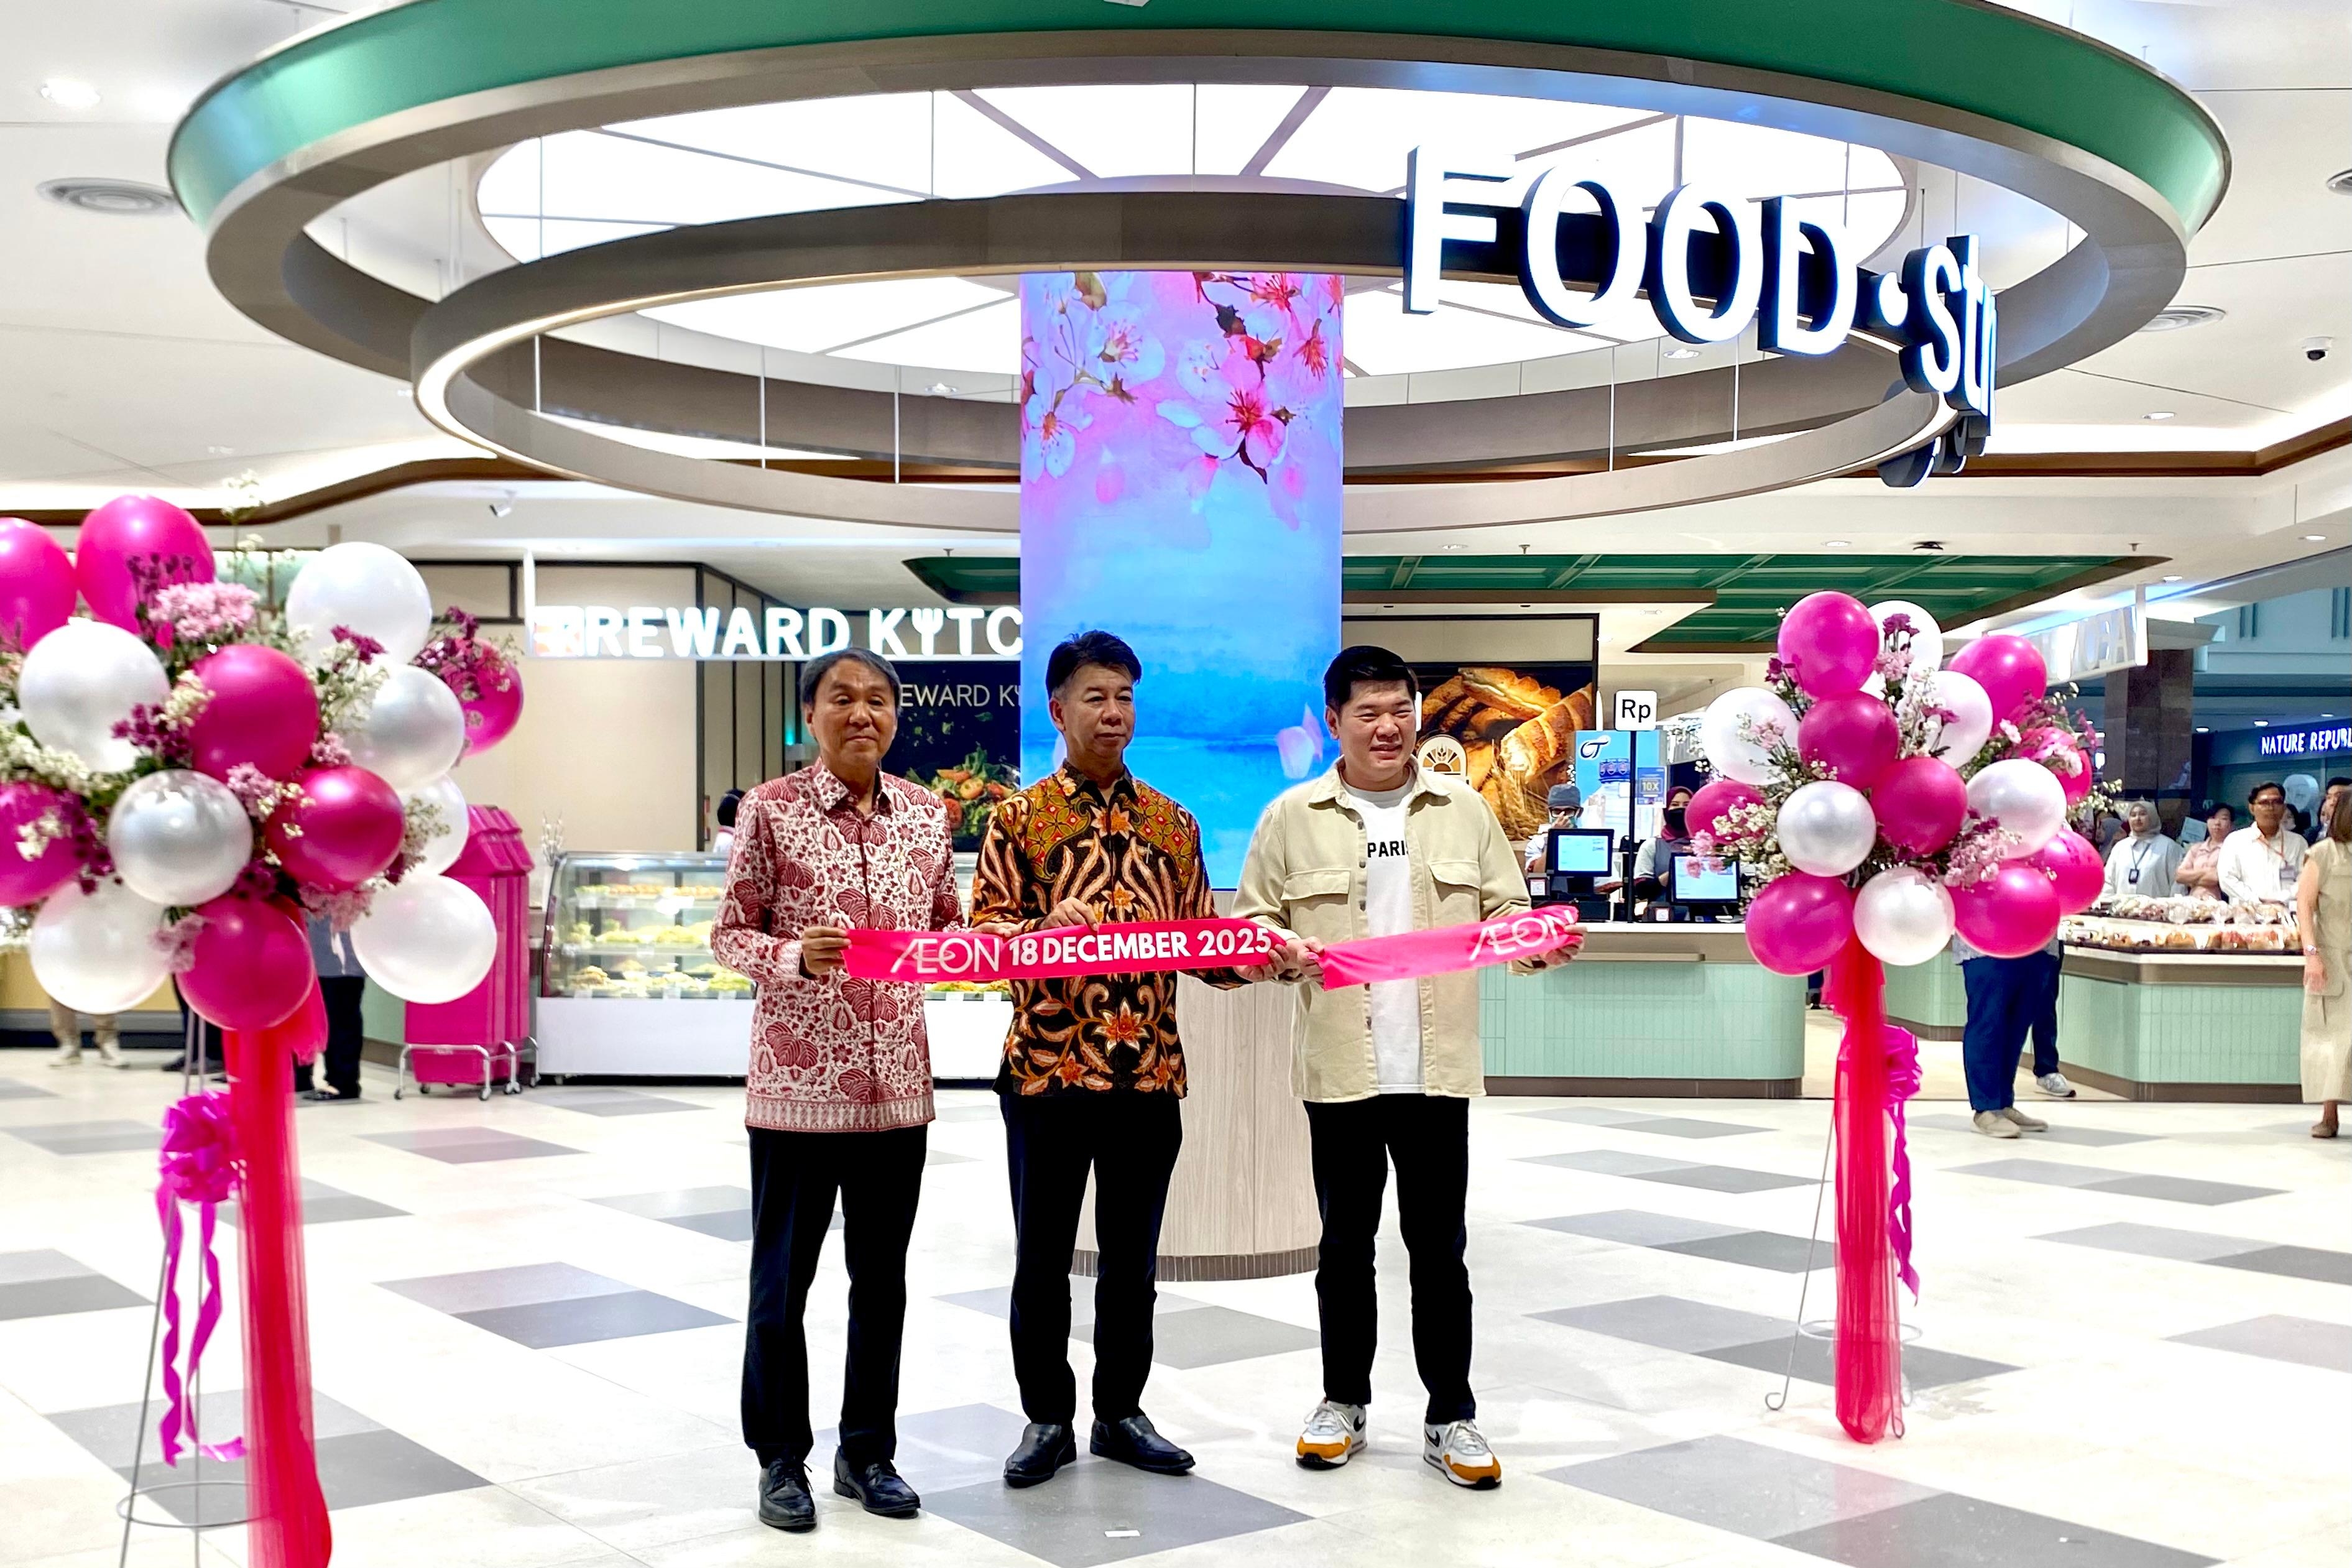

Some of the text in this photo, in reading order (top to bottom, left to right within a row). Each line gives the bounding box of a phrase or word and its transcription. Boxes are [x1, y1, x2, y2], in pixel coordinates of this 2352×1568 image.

[585, 606, 850, 657] REWARD
[900, 685, 990, 707] EWARD
[1621, 699, 1651, 723] Rp
[2261, 732, 2305, 755] NATURE
[1368, 841, 1408, 858] PARI
[1009, 938, 1038, 966] 18
[1043, 931, 1191, 965] DECEMBER
[1197, 928, 1271, 957] 2025
